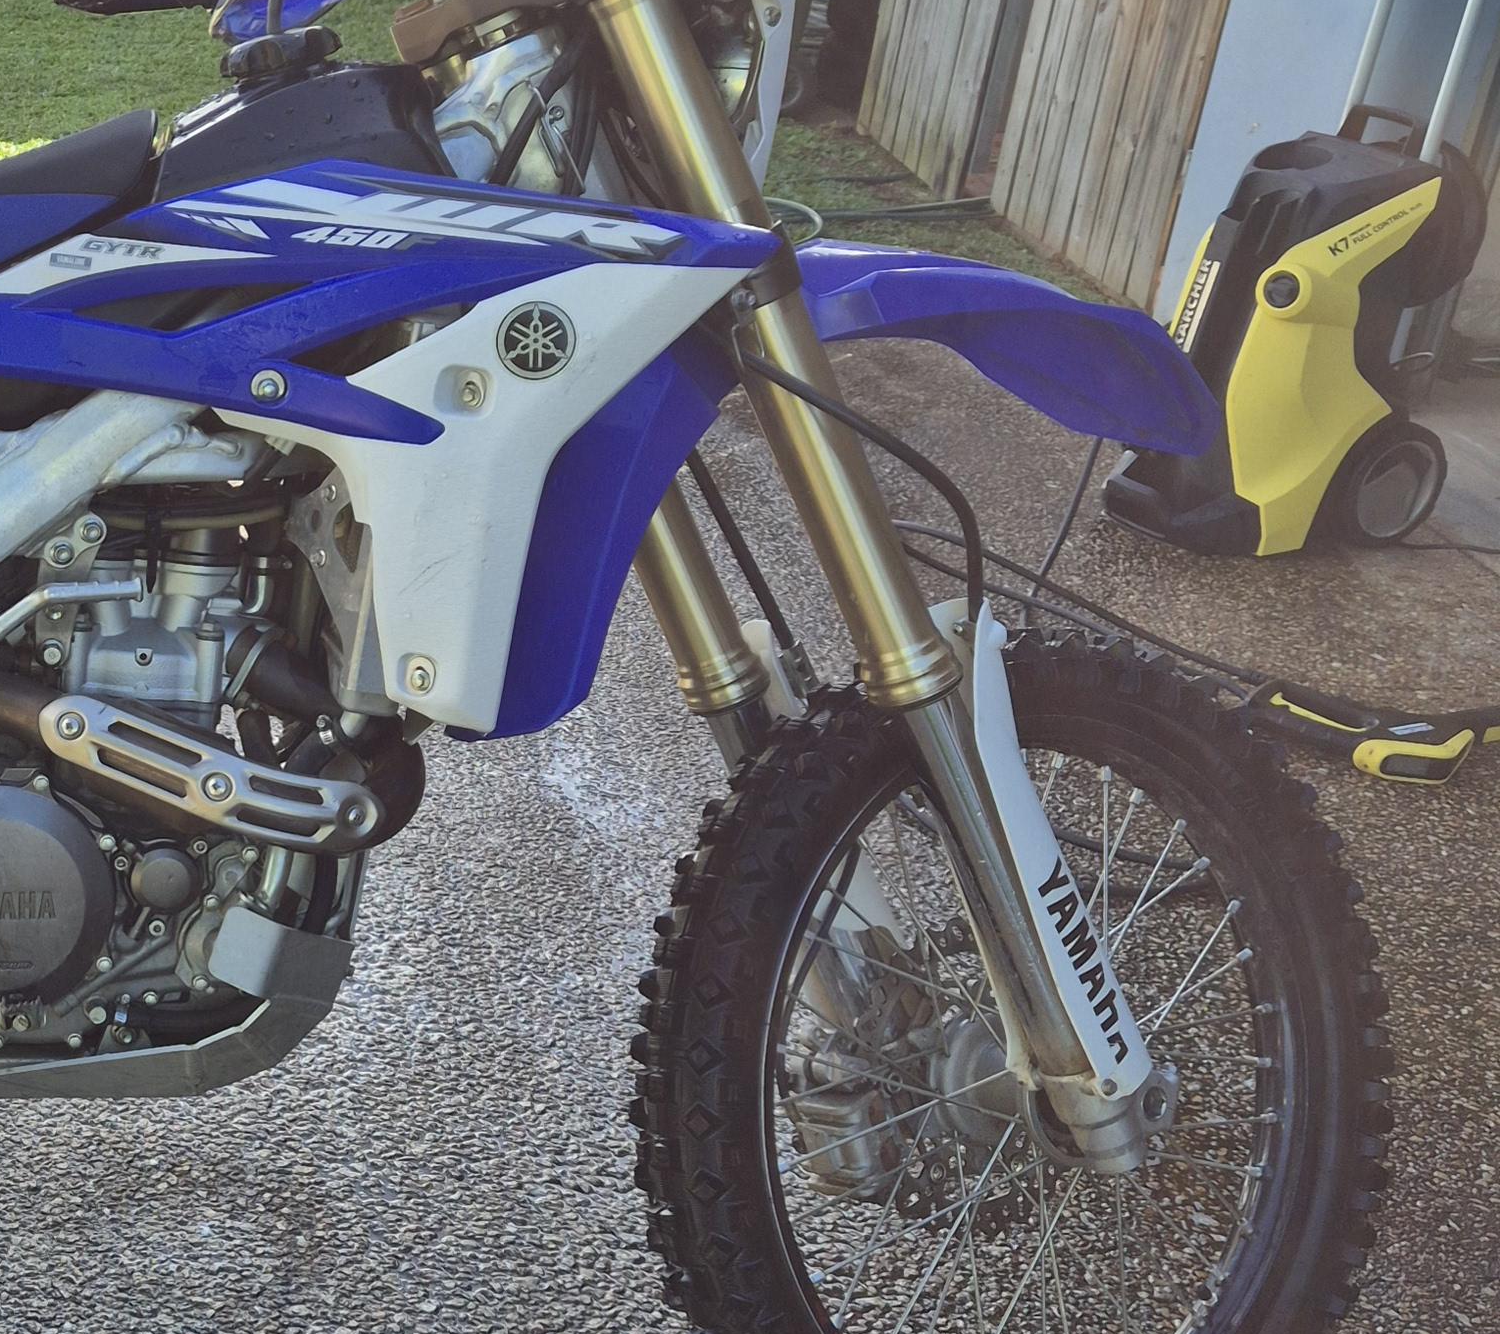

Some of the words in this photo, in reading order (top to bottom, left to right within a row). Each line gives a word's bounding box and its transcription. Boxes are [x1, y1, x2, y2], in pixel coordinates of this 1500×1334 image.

[290, 226, 439, 250] 450F
[340, 190, 685, 252] WR
[1328, 236, 1349, 256] K7
[1353, 231, 1373, 244] FULL
[1372, 209, 1409, 233] CONTROL
[81, 238, 165, 259] GYTR
